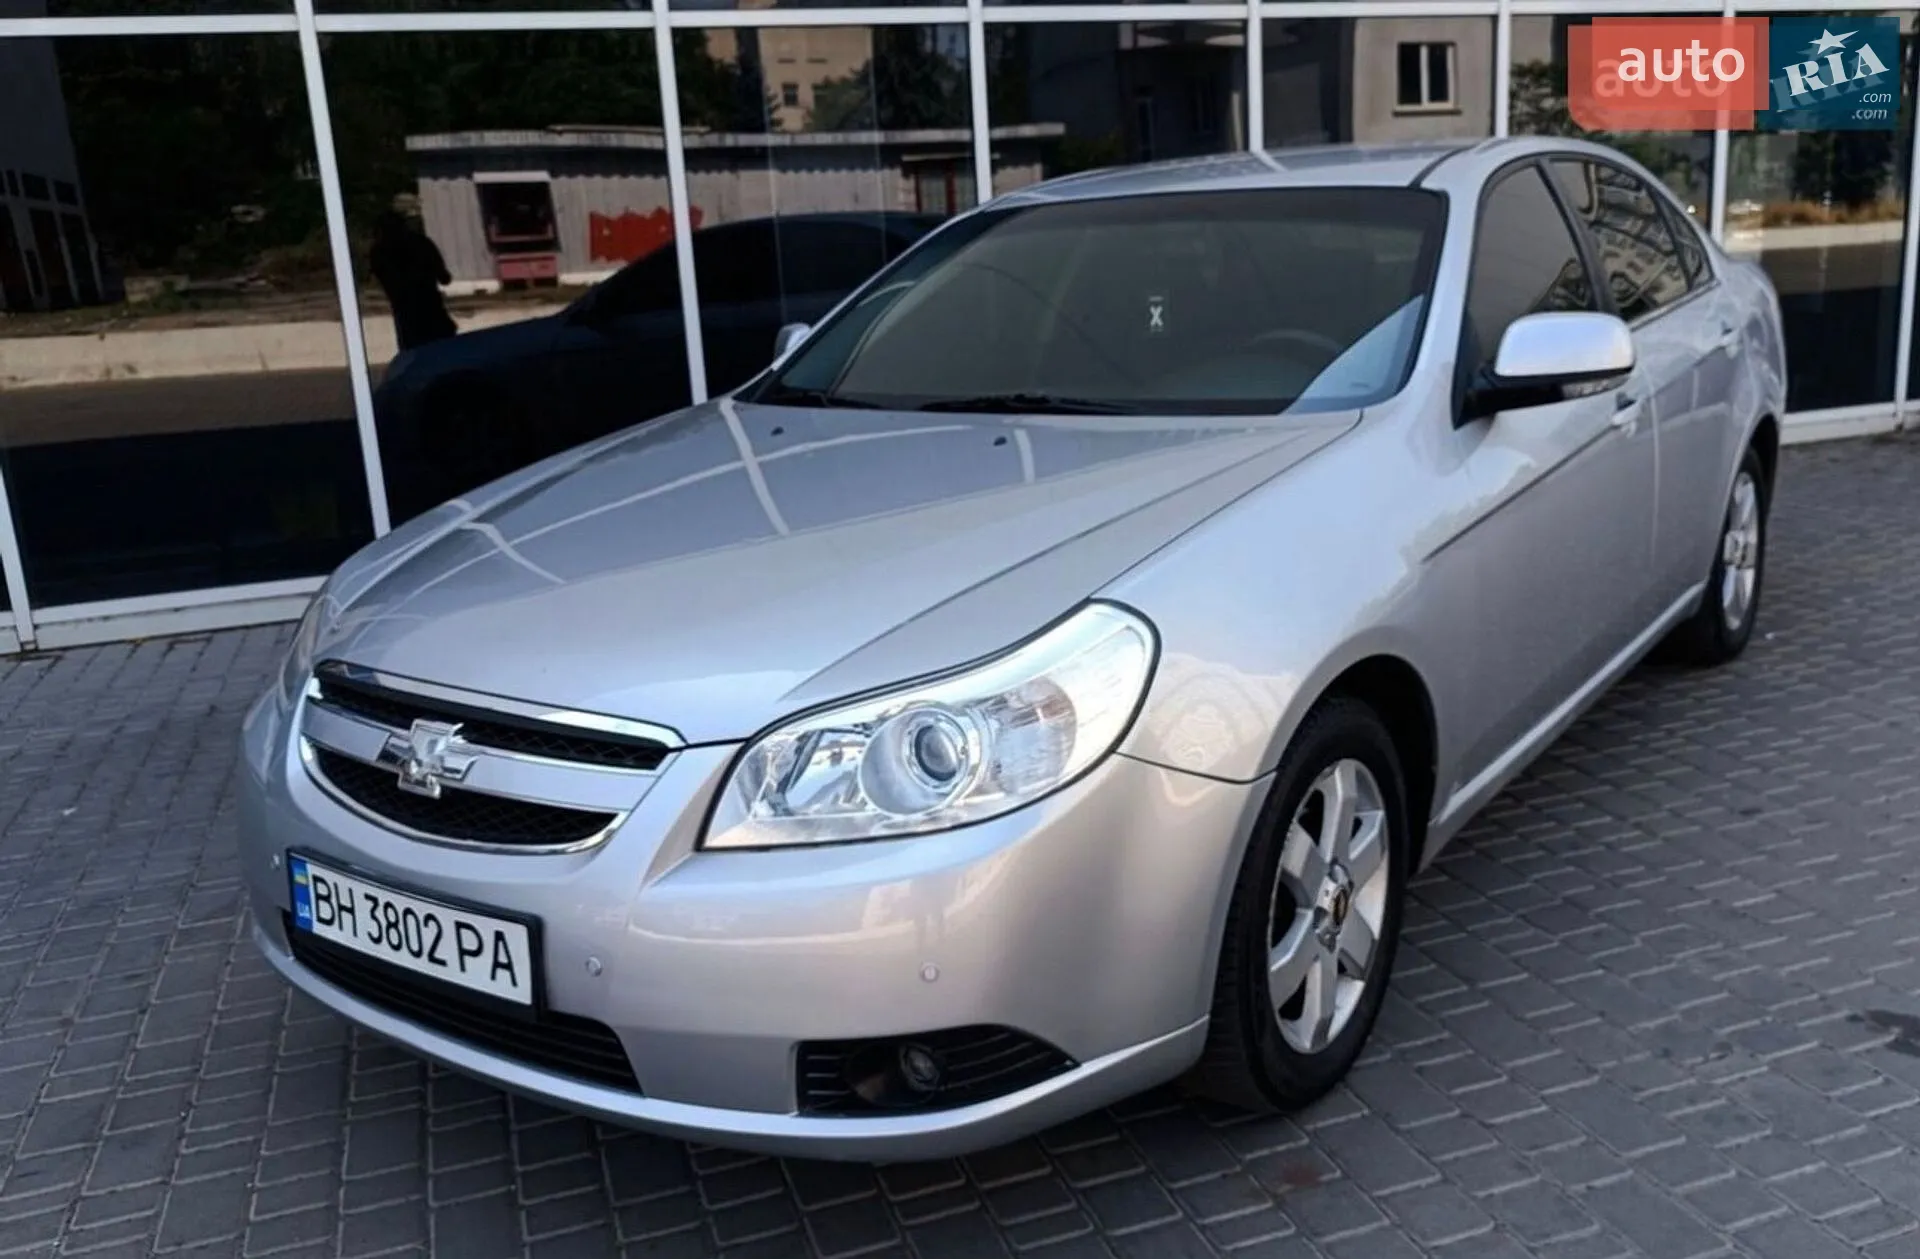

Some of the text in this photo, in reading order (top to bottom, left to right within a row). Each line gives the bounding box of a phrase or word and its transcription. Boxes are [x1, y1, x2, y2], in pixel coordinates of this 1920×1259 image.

[312, 874, 519, 988] BH 3802 PA
